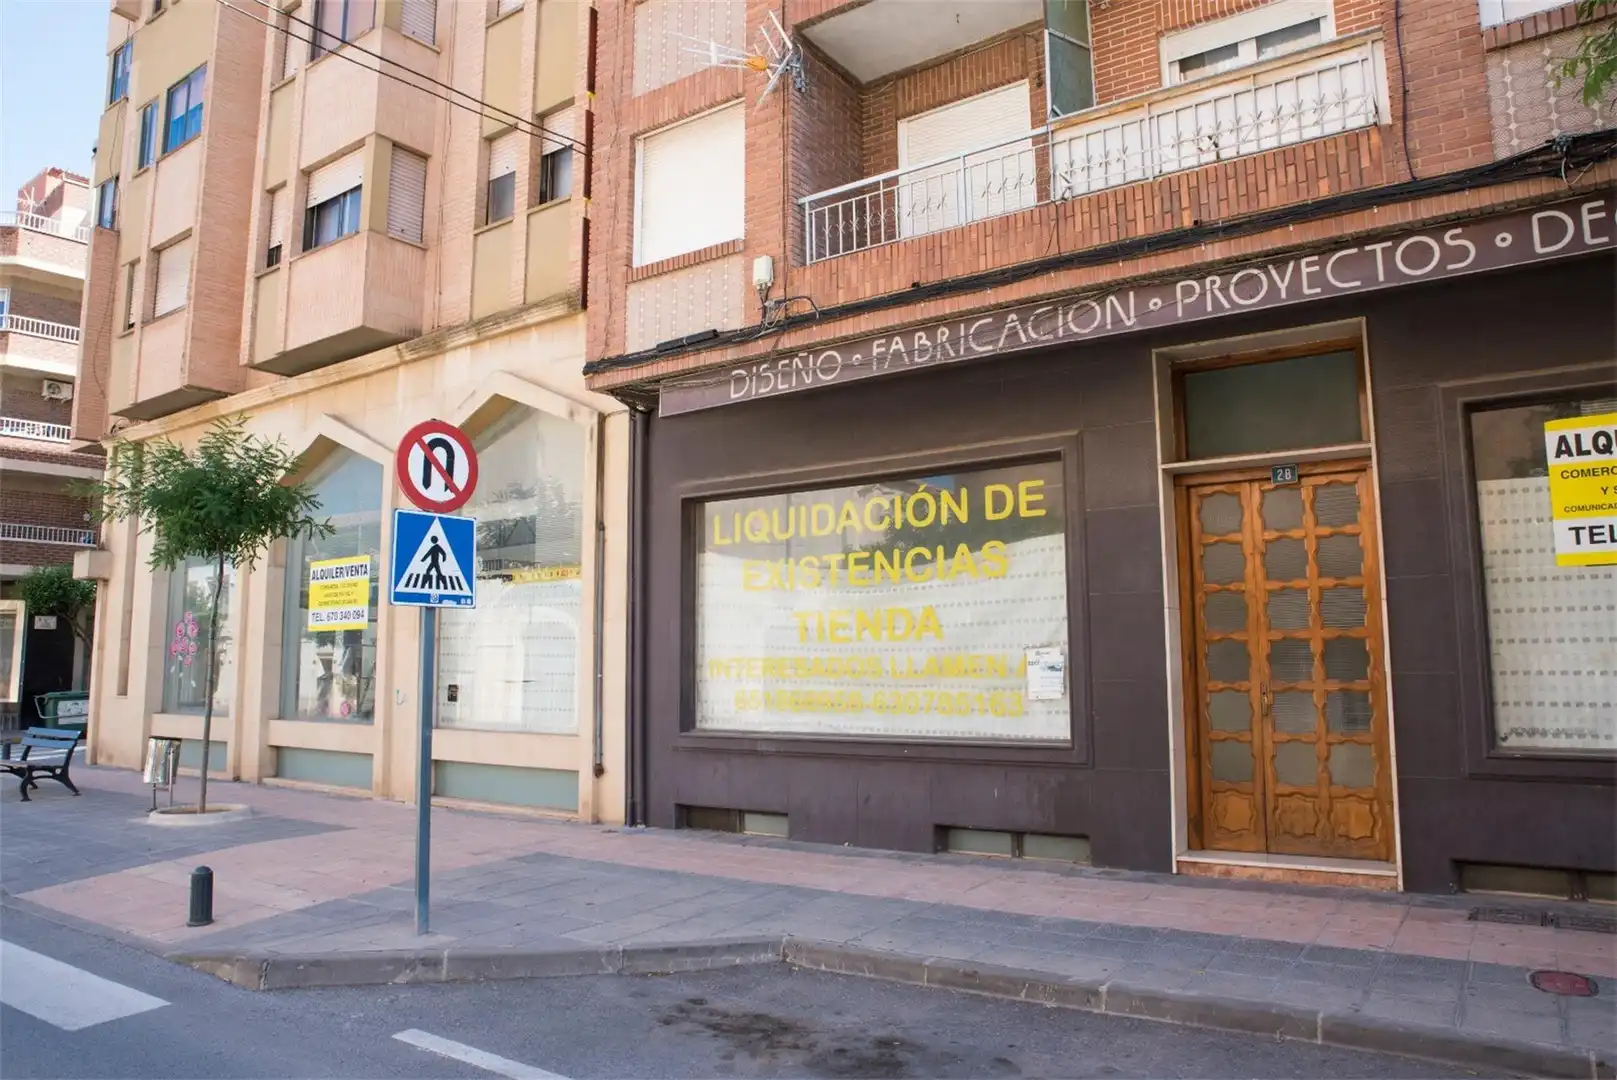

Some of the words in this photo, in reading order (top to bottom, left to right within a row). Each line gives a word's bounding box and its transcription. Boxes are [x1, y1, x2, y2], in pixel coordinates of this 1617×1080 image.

[729, 350, 841, 401] DISEÑO
[1175, 227, 1476, 317] PROYECTOS
[1531, 199, 1617, 254] DE
[1555, 429, 1617, 459] ALQ
[1276, 468, 1292, 481] 28
[1601, 486, 1609, 495] Y
[713, 484, 968, 546] LIQUIDACIÓN
[983, 479, 1046, 521] DE
[743, 540, 1010, 592] EXISTENCIAS
[327, 611, 338, 621] 670
[792, 605, 944, 643] TIENDA
[708, 655, 882, 680] INTERESADOS
[889, 654, 1007, 679] LLAMEN
